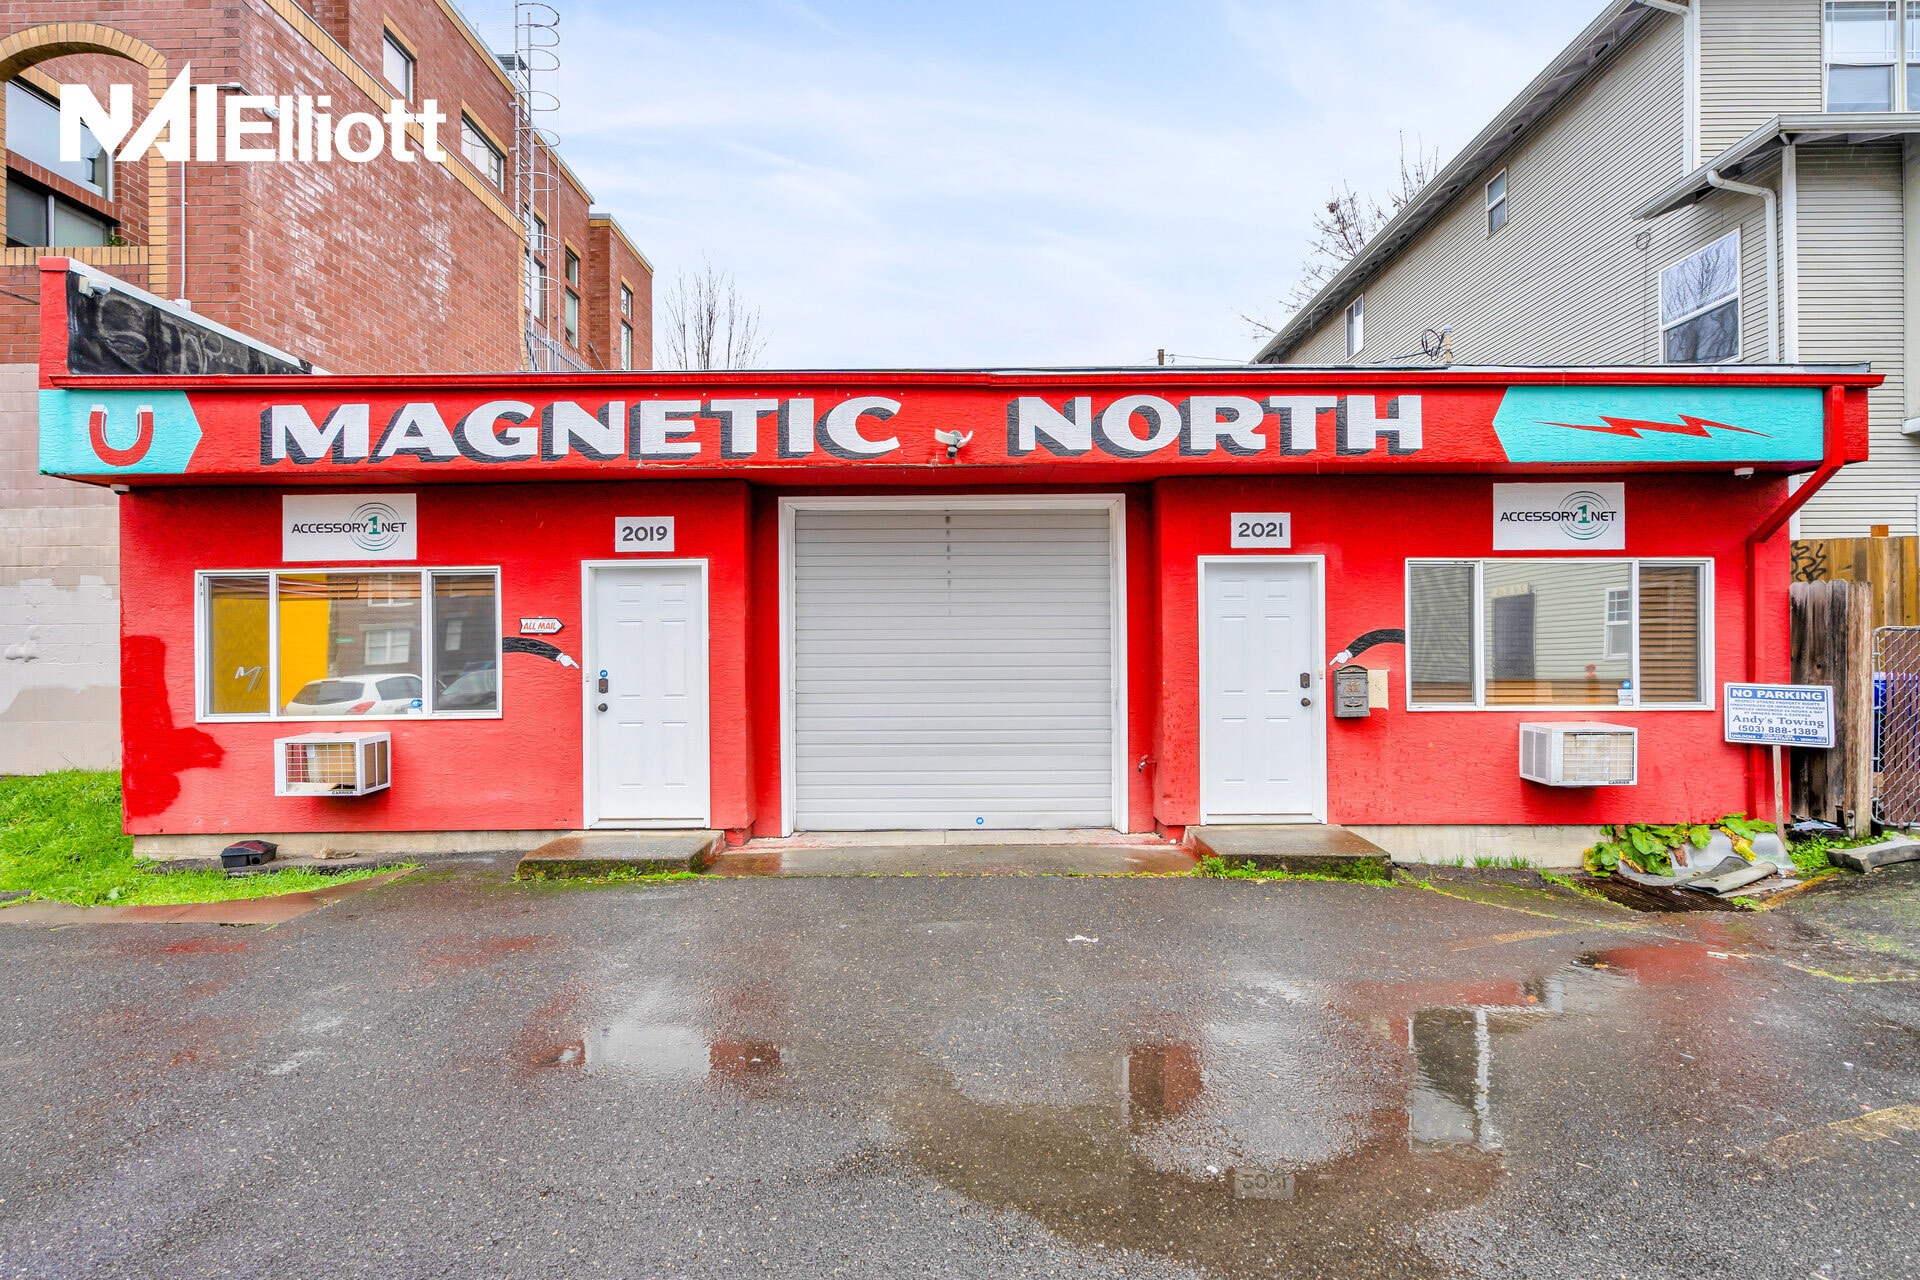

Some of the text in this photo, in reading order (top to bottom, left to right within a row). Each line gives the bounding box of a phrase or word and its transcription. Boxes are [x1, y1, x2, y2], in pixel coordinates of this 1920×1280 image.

[260, 394, 1423, 465] MAGNETIC NORTH
[622, 526, 667, 542] 2019
[1238, 522, 1283, 538] 2021
[523, 622, 556, 630] ALL MAIL
[1732, 689, 1822, 700] NO PARKING
[1732, 714, 1824, 728] Andy's Towing
[1768, 726, 1818, 736] 888-1389
